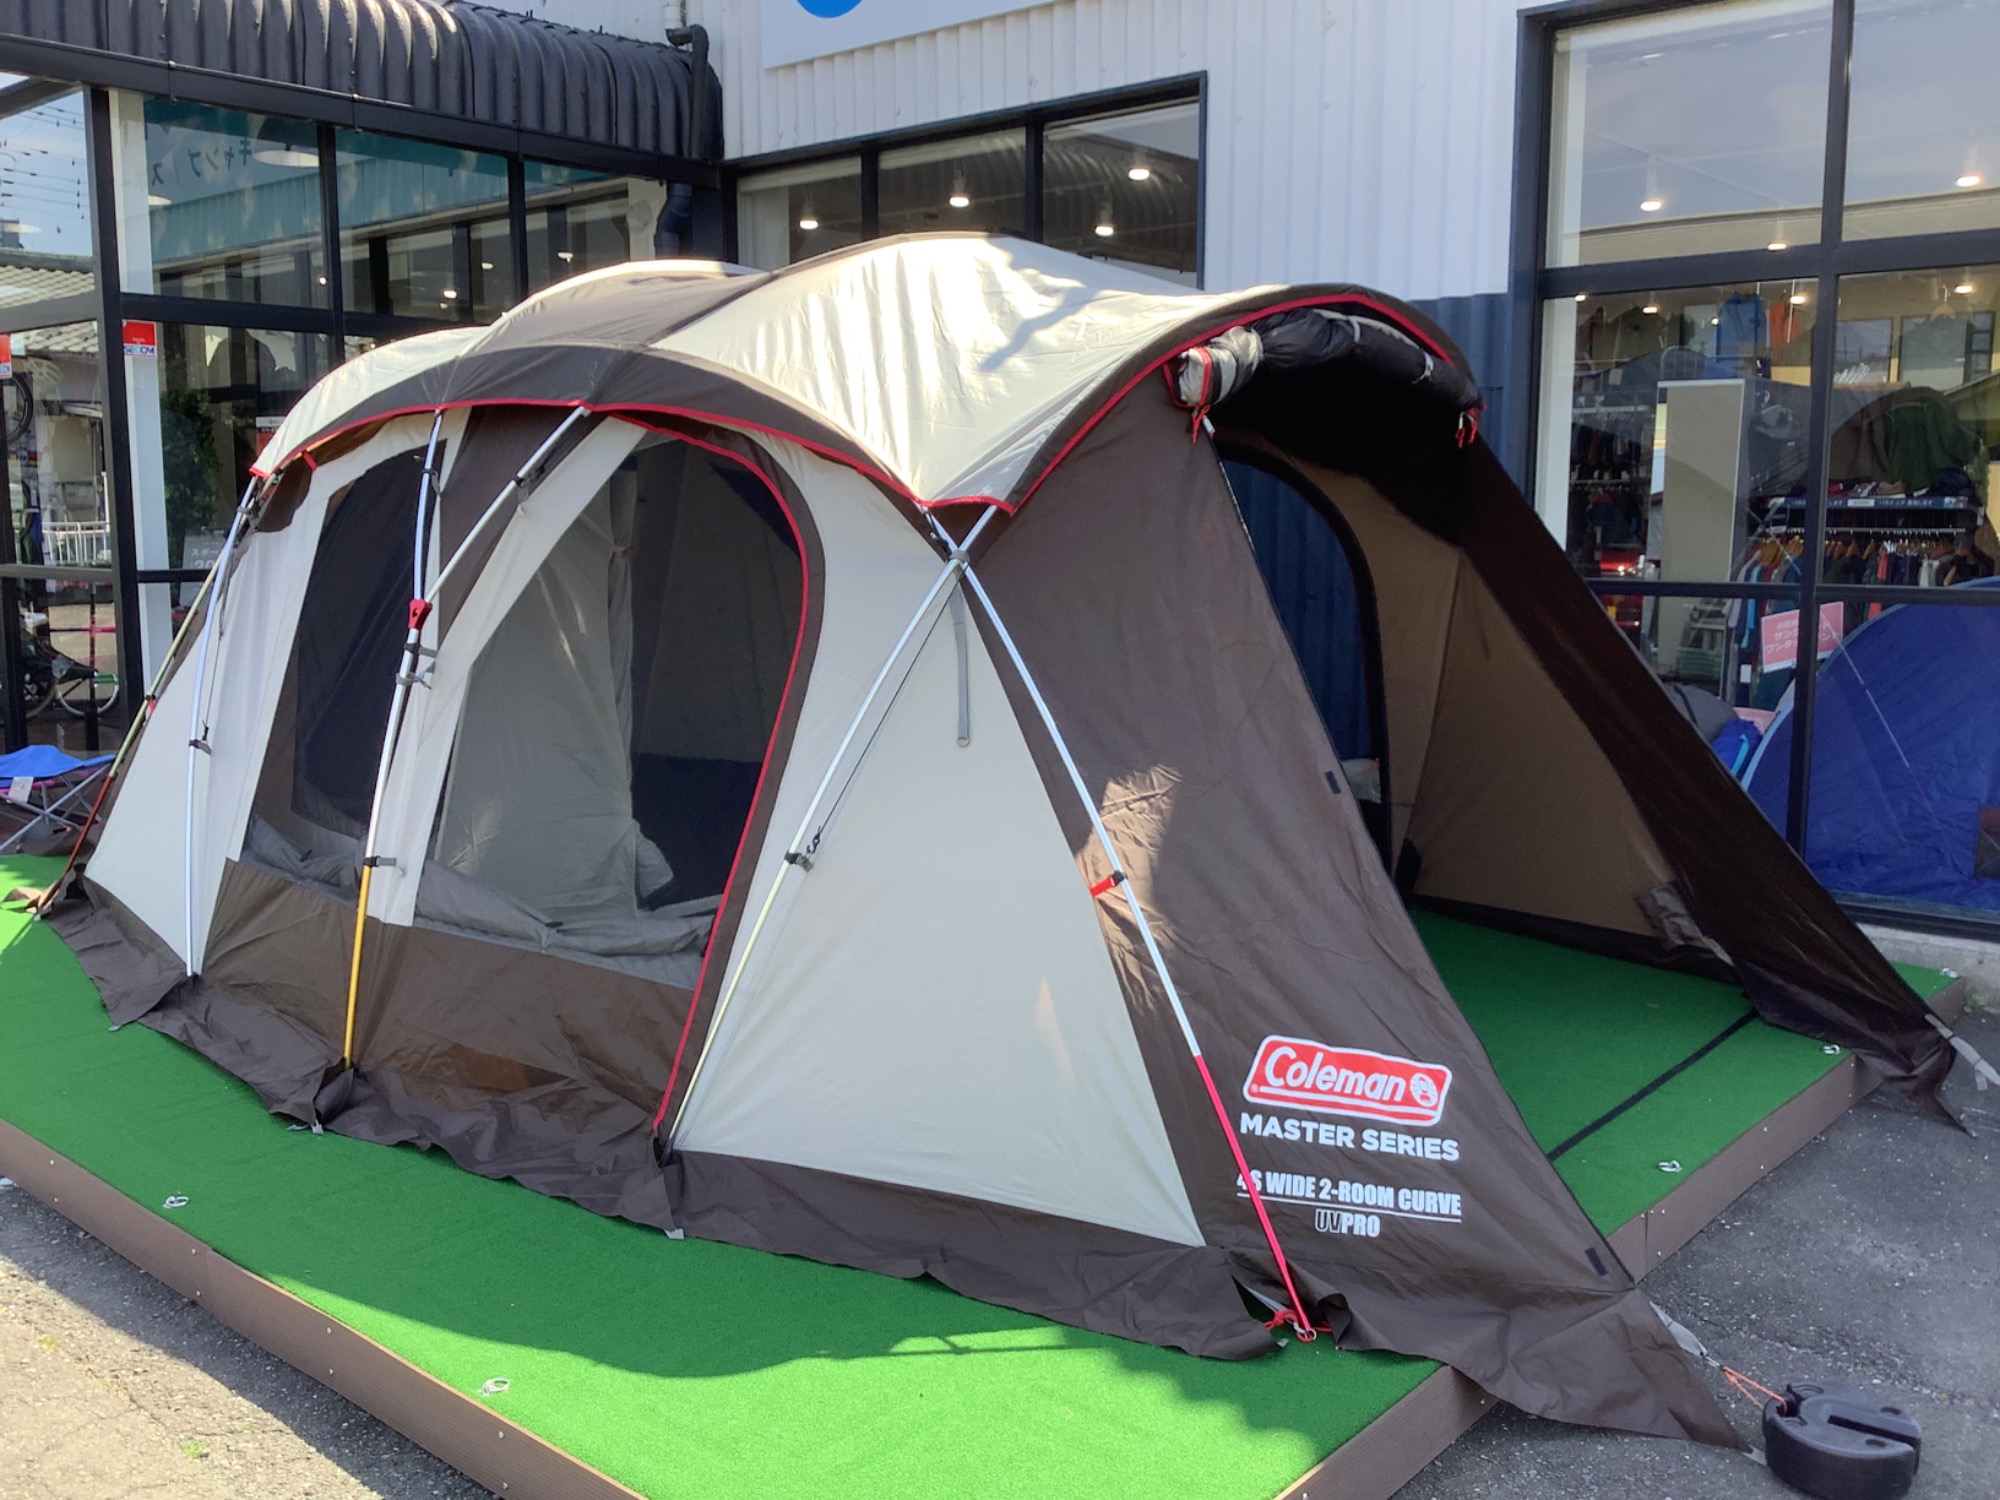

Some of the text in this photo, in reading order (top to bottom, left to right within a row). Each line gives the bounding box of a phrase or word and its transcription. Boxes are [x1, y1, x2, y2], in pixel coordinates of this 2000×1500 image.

[1265, 1046, 1406, 1102] Coleman
[1240, 1112, 1460, 1161] MASTER SERIES
[1265, 1171, 1316, 1198] WIDE
[1319, 1177, 1394, 1209] 2-ROOM
[1398, 1188, 1462, 1215] CURVE
